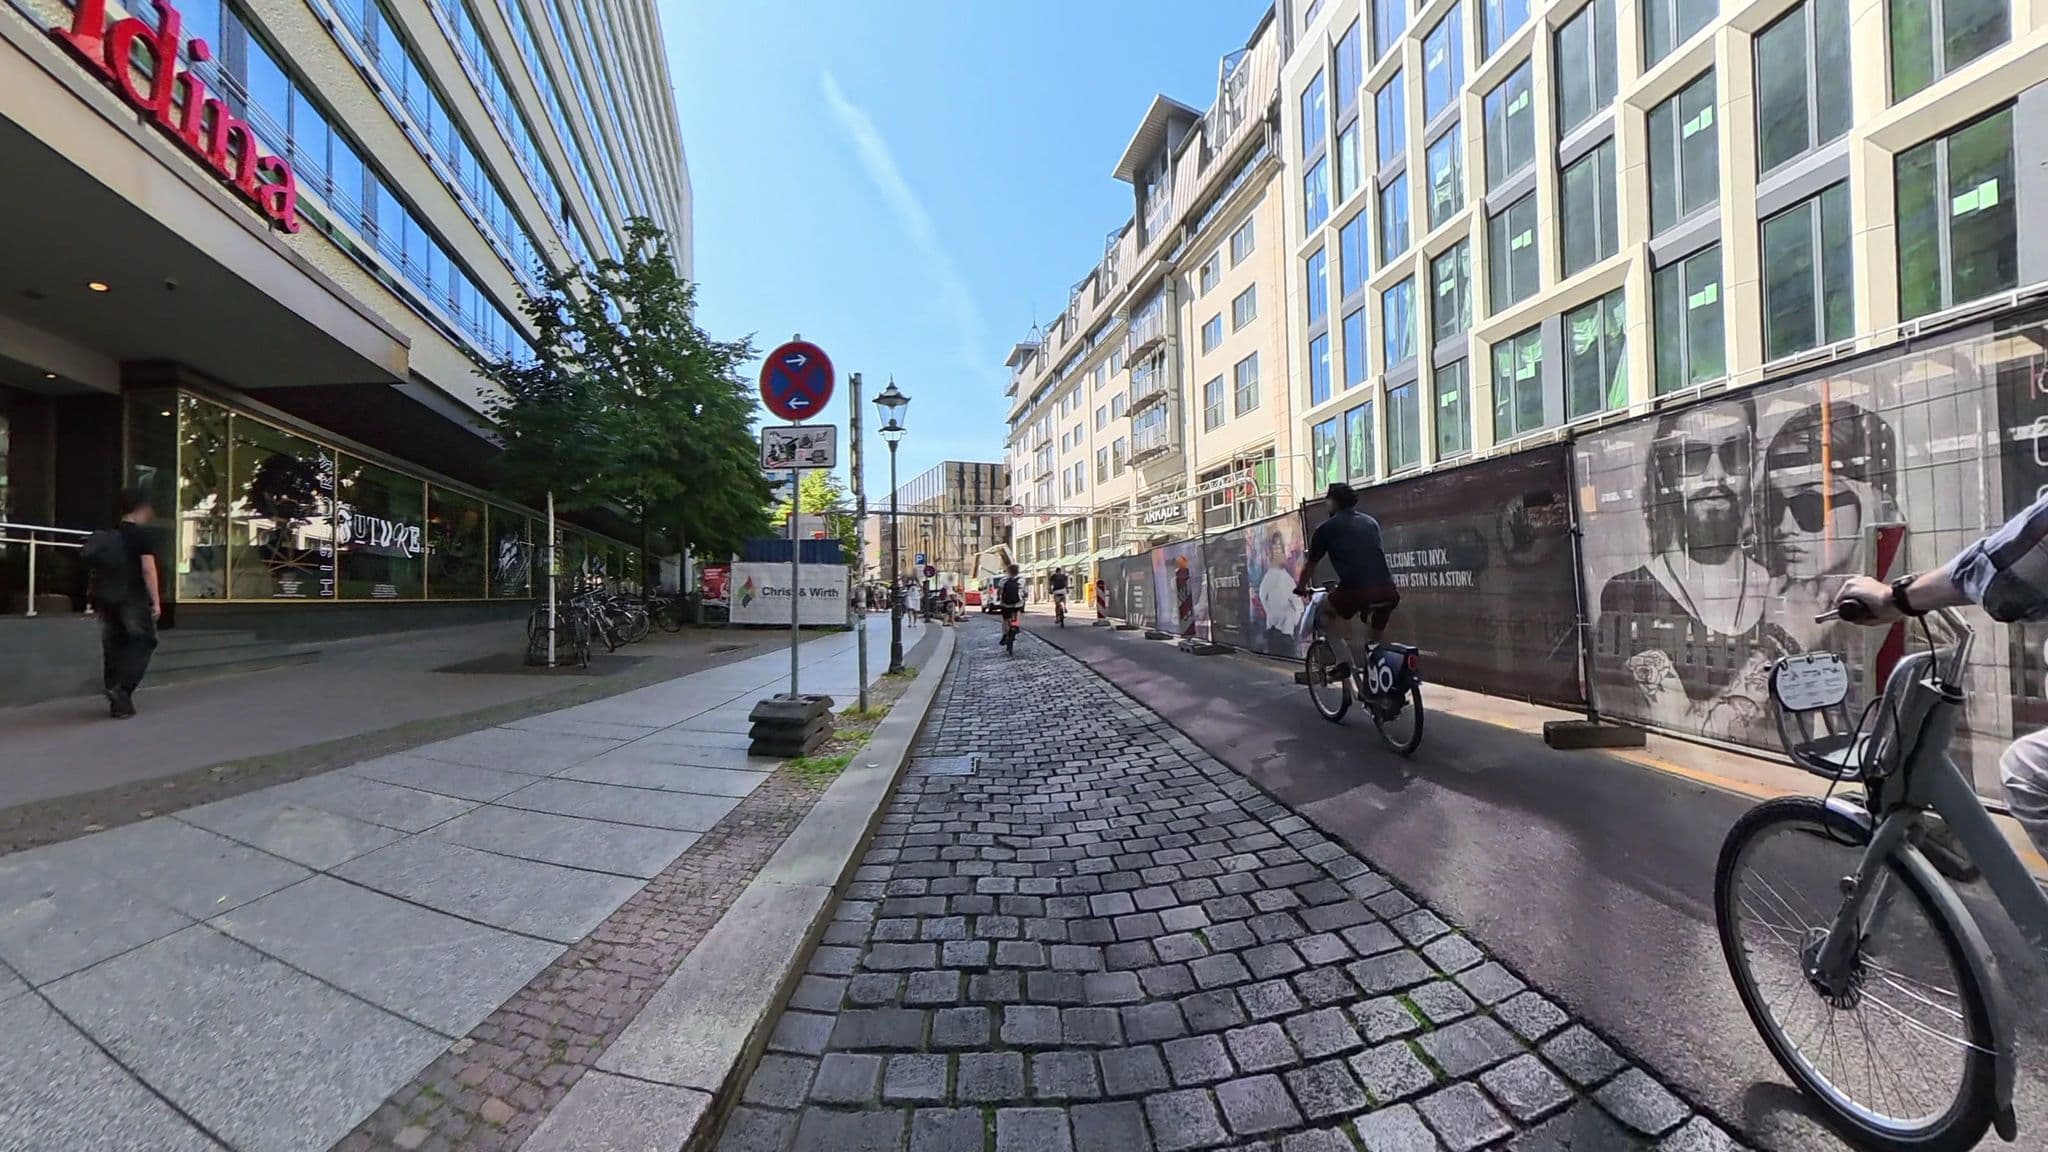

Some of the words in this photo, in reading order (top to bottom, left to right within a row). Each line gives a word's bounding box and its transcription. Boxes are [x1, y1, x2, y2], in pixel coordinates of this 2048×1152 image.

[1384, 551, 1415, 568] ELCOME
[1416, 550, 1427, 567] TO
[1429, 548, 1450, 565] NYX.
[1410, 572, 1429, 587] STAY
[1430, 572, 1439, 587] IS
[1439, 572, 1445, 587] A
[1445, 570, 1474, 587] STORY.
[761, 586, 792, 597] Chris
[798, 586, 807, 598] &
[809, 587, 839, 598] Wirth
